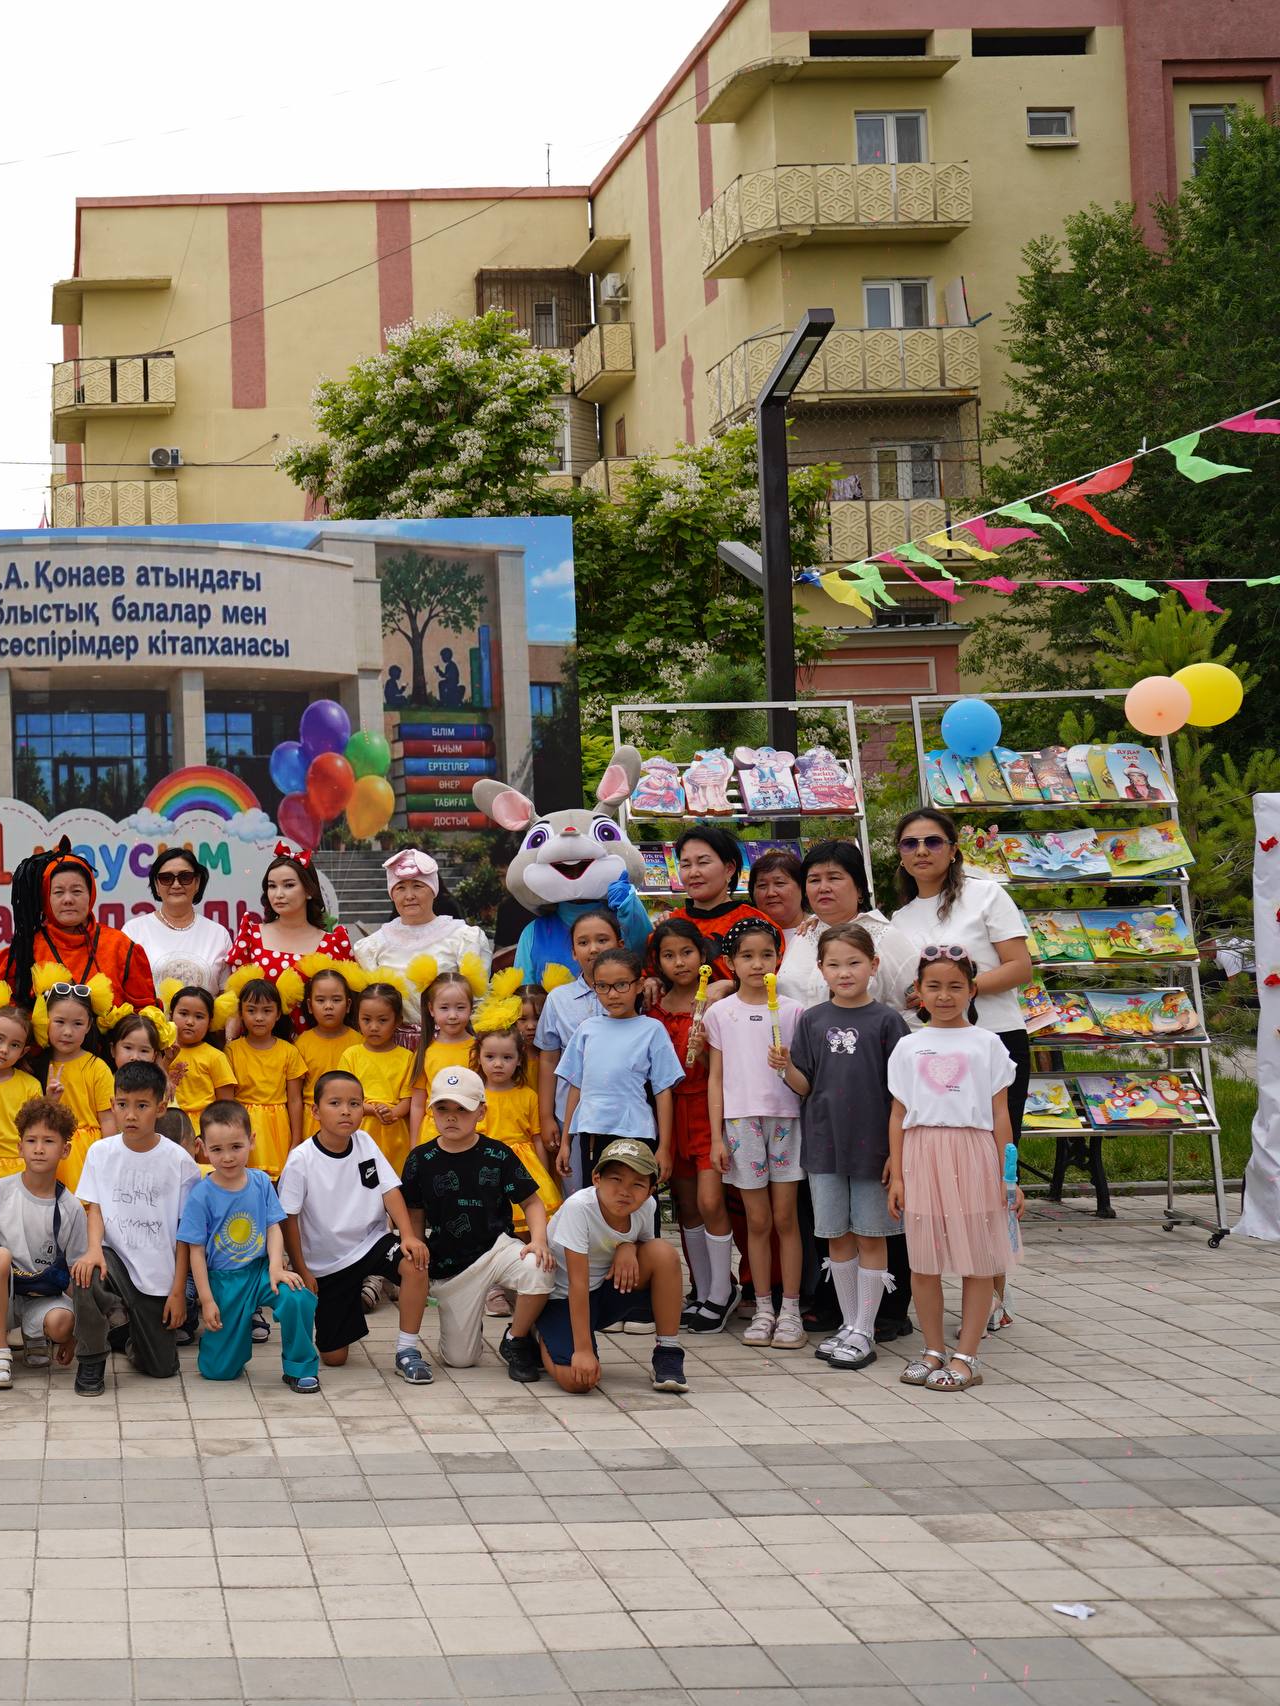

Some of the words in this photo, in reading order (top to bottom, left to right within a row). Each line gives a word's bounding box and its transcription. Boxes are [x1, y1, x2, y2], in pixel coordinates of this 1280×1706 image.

[35, 560, 125, 593] Қонаев
[135, 564, 261, 594] атындағы
[112, 595, 212, 629] балалар
[222, 603, 267, 626] мен
[147, 629, 290, 658] кітапханасы
[431, 727, 455, 737] БІЛІМ
[432, 744, 463, 754] ТАНЫМ
[438, 780, 461, 789] ӨНЕР
[434, 798, 468, 807] ТАБИҒАТ
[433, 816, 470, 827] ДОСТЫҚ
[483, 1147, 510, 1161] PLAY
